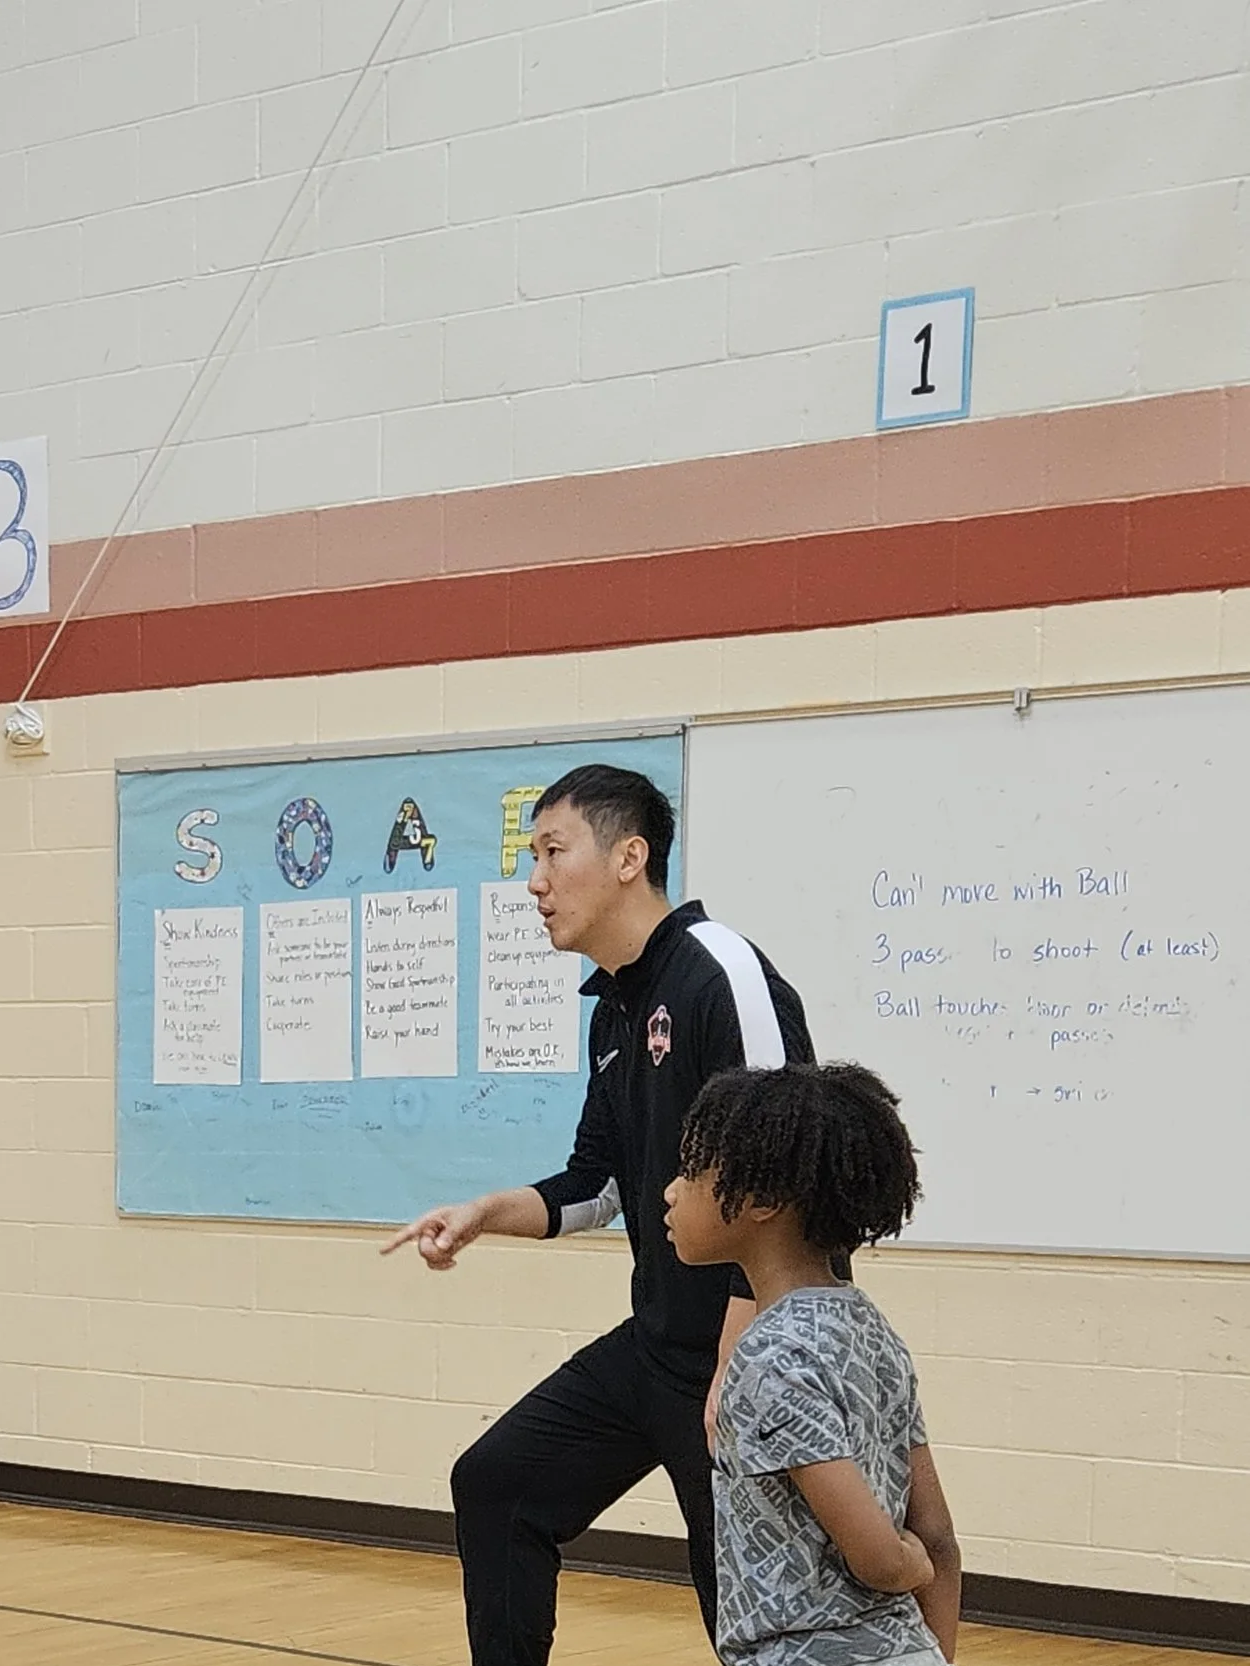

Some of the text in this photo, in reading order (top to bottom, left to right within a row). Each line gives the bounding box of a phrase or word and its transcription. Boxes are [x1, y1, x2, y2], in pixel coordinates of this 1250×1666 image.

[911, 323, 936, 395] 1
[941, 881, 999, 907] move
[1013, 873, 1062, 901] with
[1076, 866, 1128, 896] Ball
[365, 898, 402, 926] Always
[513, 927, 530, 942] PE
[872, 933, 891, 964] 3
[1032, 938, 1099, 962] shoot
[406, 956, 427, 972] self
[488, 975, 550, 997] Participating
[504, 994, 518, 1008] all
[874, 990, 920, 1018] Ball
[1087, 1002, 1109, 1016] or
[414, 1021, 440, 1037] hand
[485, 1016, 554, 1040] Try your best
[485, 1045, 526, 1060] Mistakes
